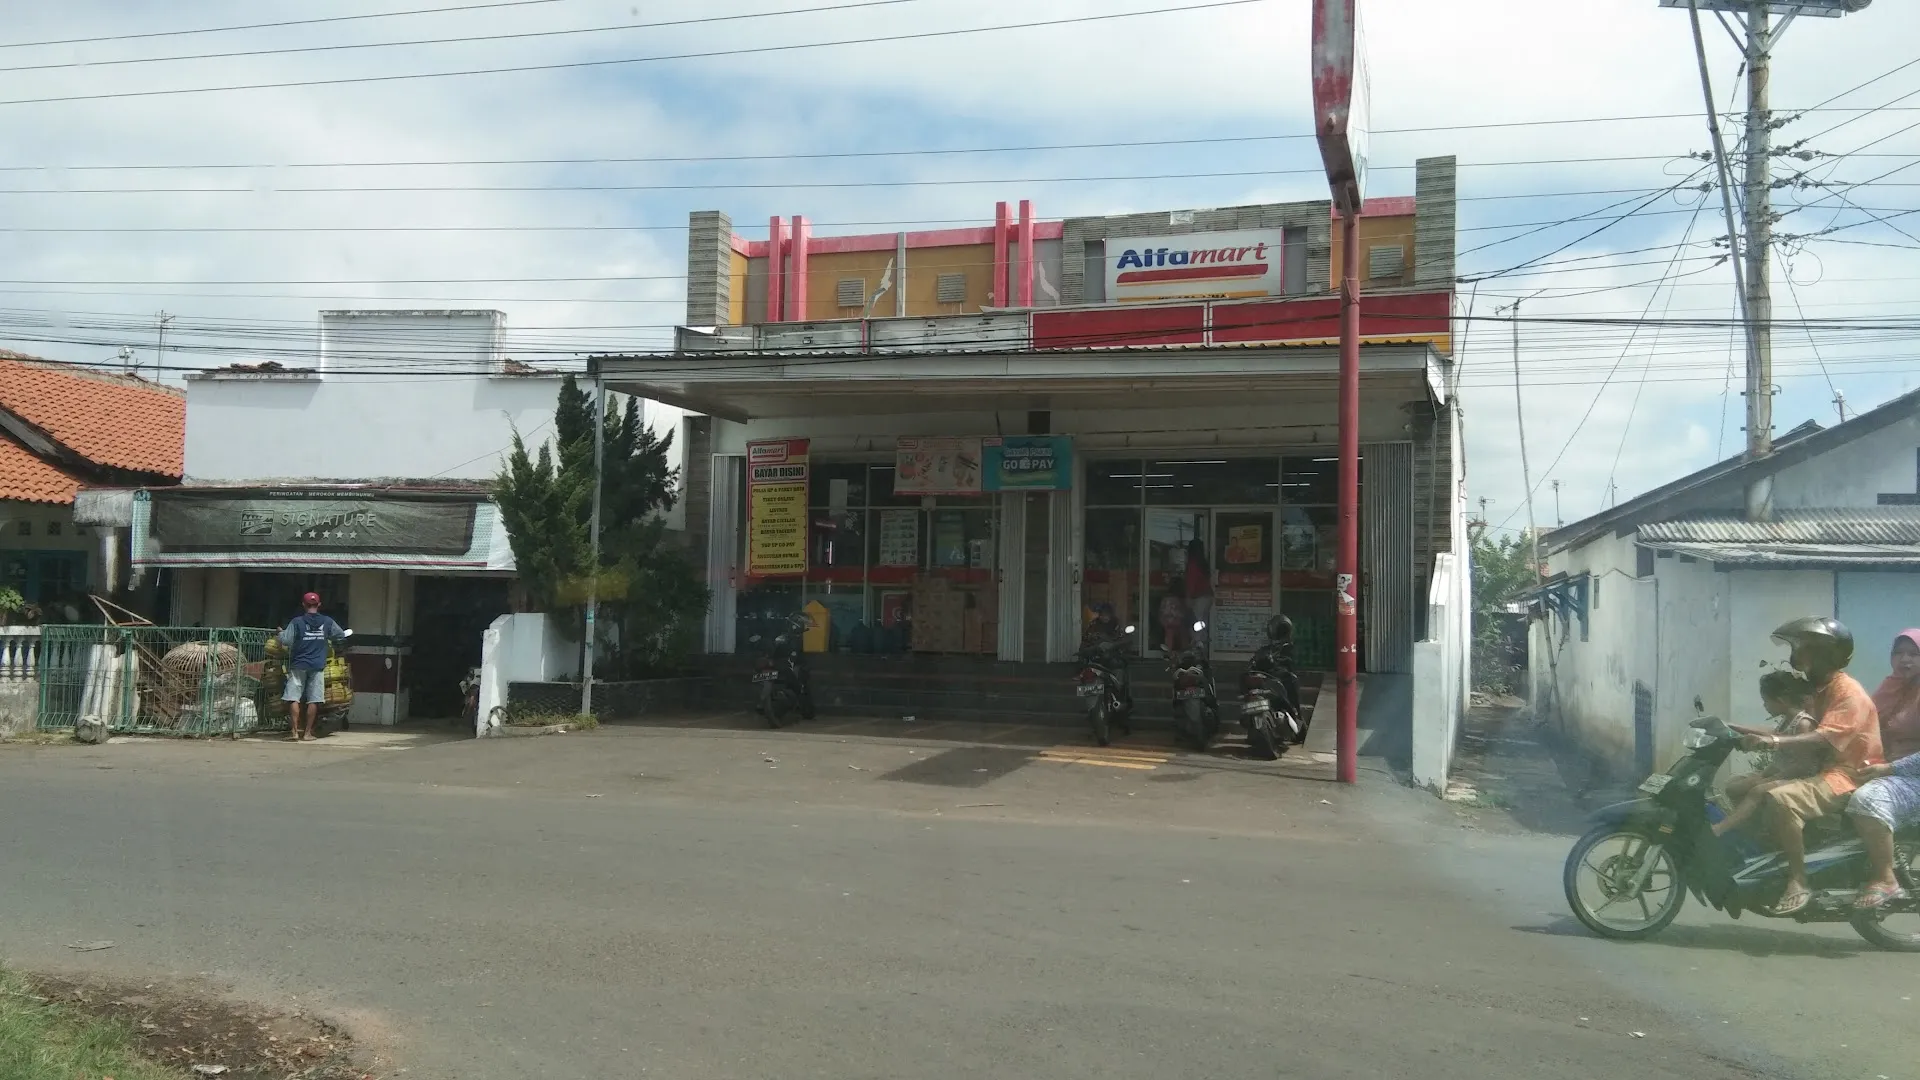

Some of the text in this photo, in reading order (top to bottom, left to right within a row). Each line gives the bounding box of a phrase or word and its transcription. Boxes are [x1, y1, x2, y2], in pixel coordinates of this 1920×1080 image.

[1116, 242, 1268, 269] Alfamart
[752, 446, 784, 455] Alfamart
[1003, 459, 1055, 470] GO PAY
[754, 466, 804, 478] BAYAR DISINI
[281, 512, 377, 528] SIGNATURE
